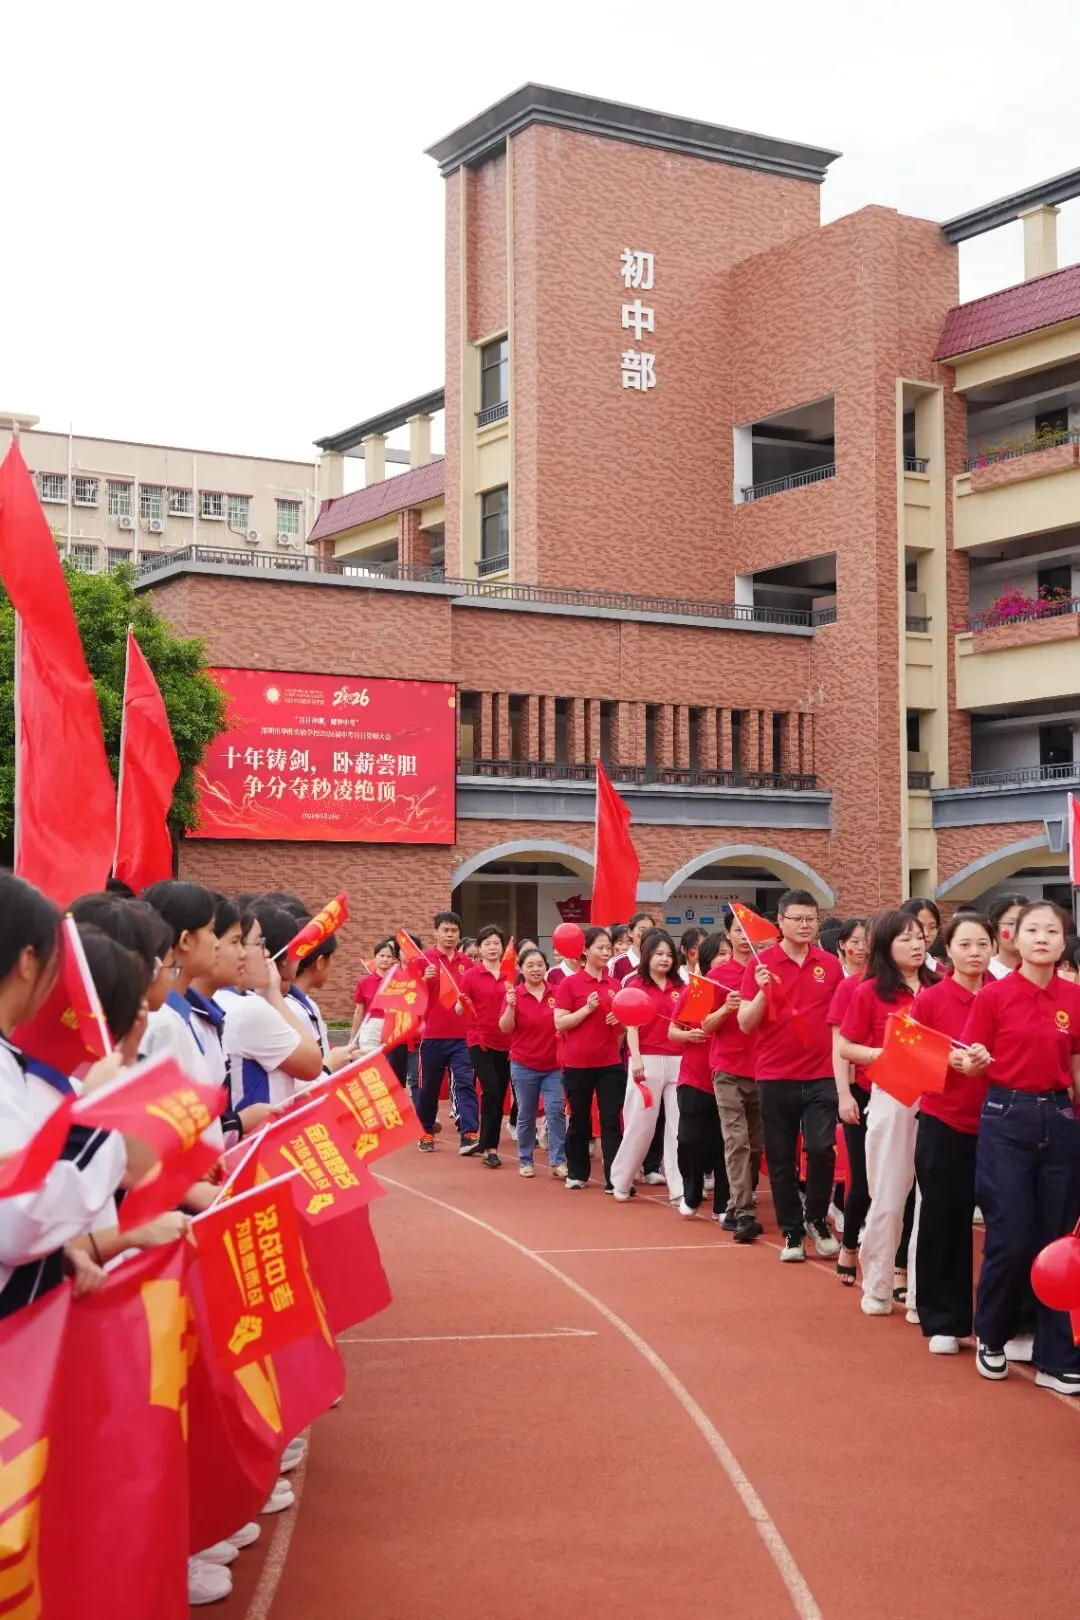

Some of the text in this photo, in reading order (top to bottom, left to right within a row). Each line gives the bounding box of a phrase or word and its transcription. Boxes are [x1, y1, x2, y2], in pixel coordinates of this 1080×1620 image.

[619, 247, 657, 393] 初中部
[219, 746, 418, 777] 十年铸剑，卧薪尝胆
[243, 775, 396, 803] 争分夺秒凌绝顶
[254, 1204, 295, 1312] 决战中考
